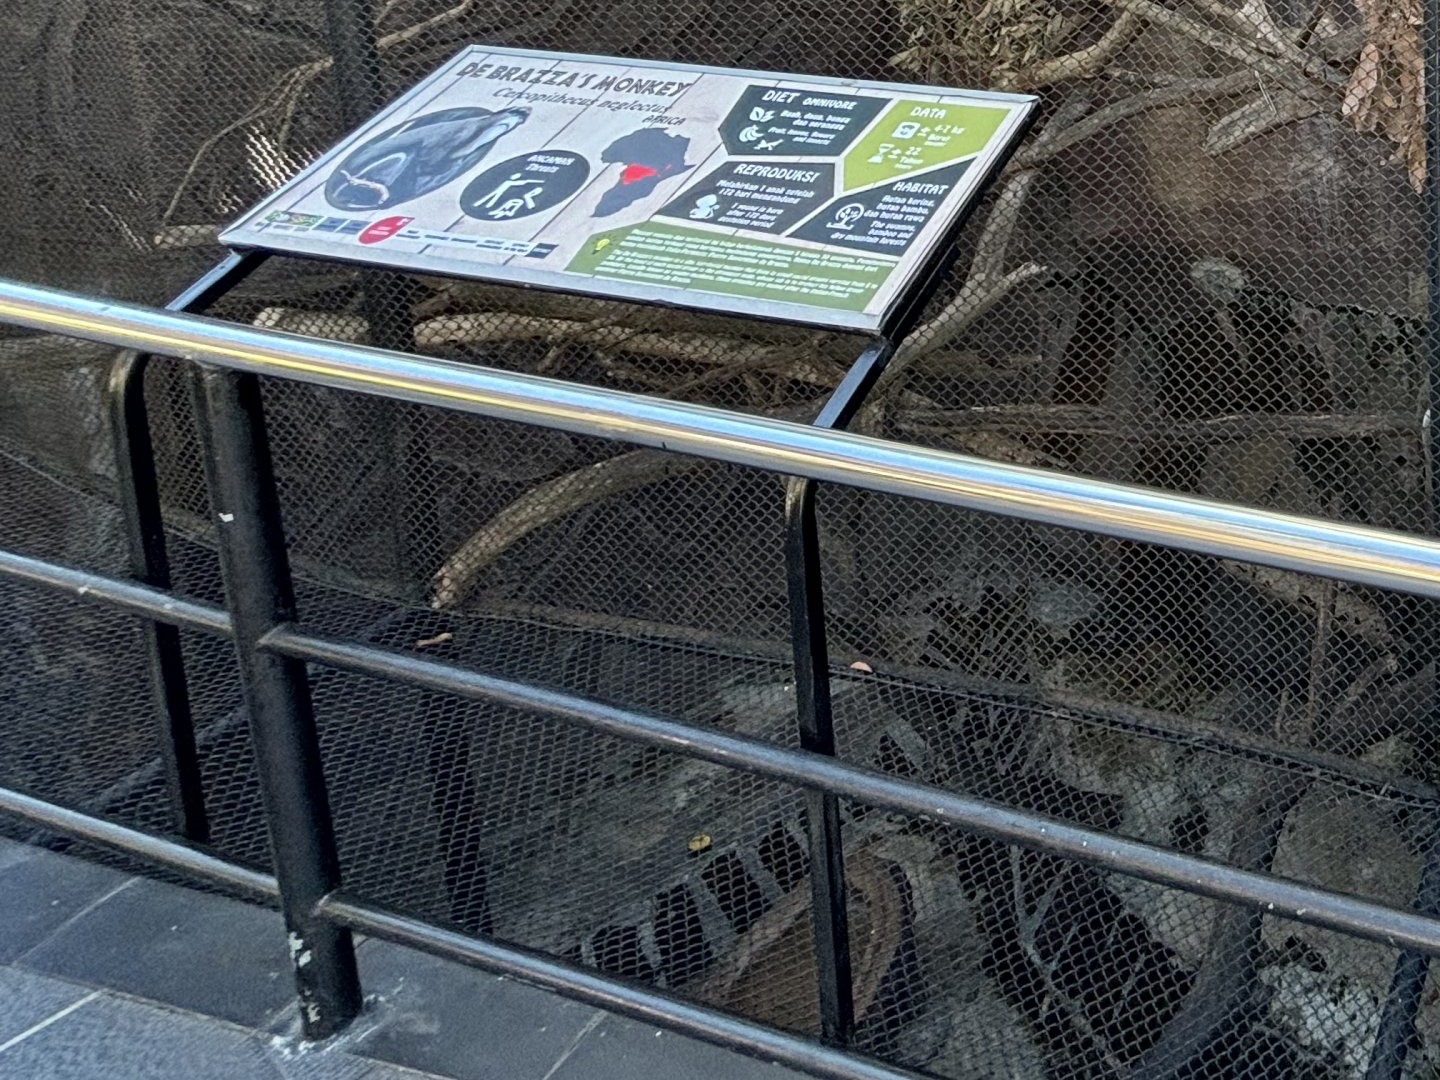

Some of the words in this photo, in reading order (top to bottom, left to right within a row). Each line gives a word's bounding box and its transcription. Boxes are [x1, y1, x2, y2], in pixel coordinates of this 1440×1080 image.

[456, 62, 493, 78] DE
[486, 65, 598, 88] BRAZZA'S
[590, 76, 694, 97] MONKEY
[493, 87, 598, 106] Cercopithecus
[597, 100, 672, 114] neglectus
[762, 90, 800, 103] DIET
[802, 97, 857, 110] OMNIVORE
[641, 114, 687, 126] AFRICA
[910, 106, 947, 119] DATA
[733, 163, 820, 183] REPRODUKSI
[893, 181, 949, 195] HABITAT
